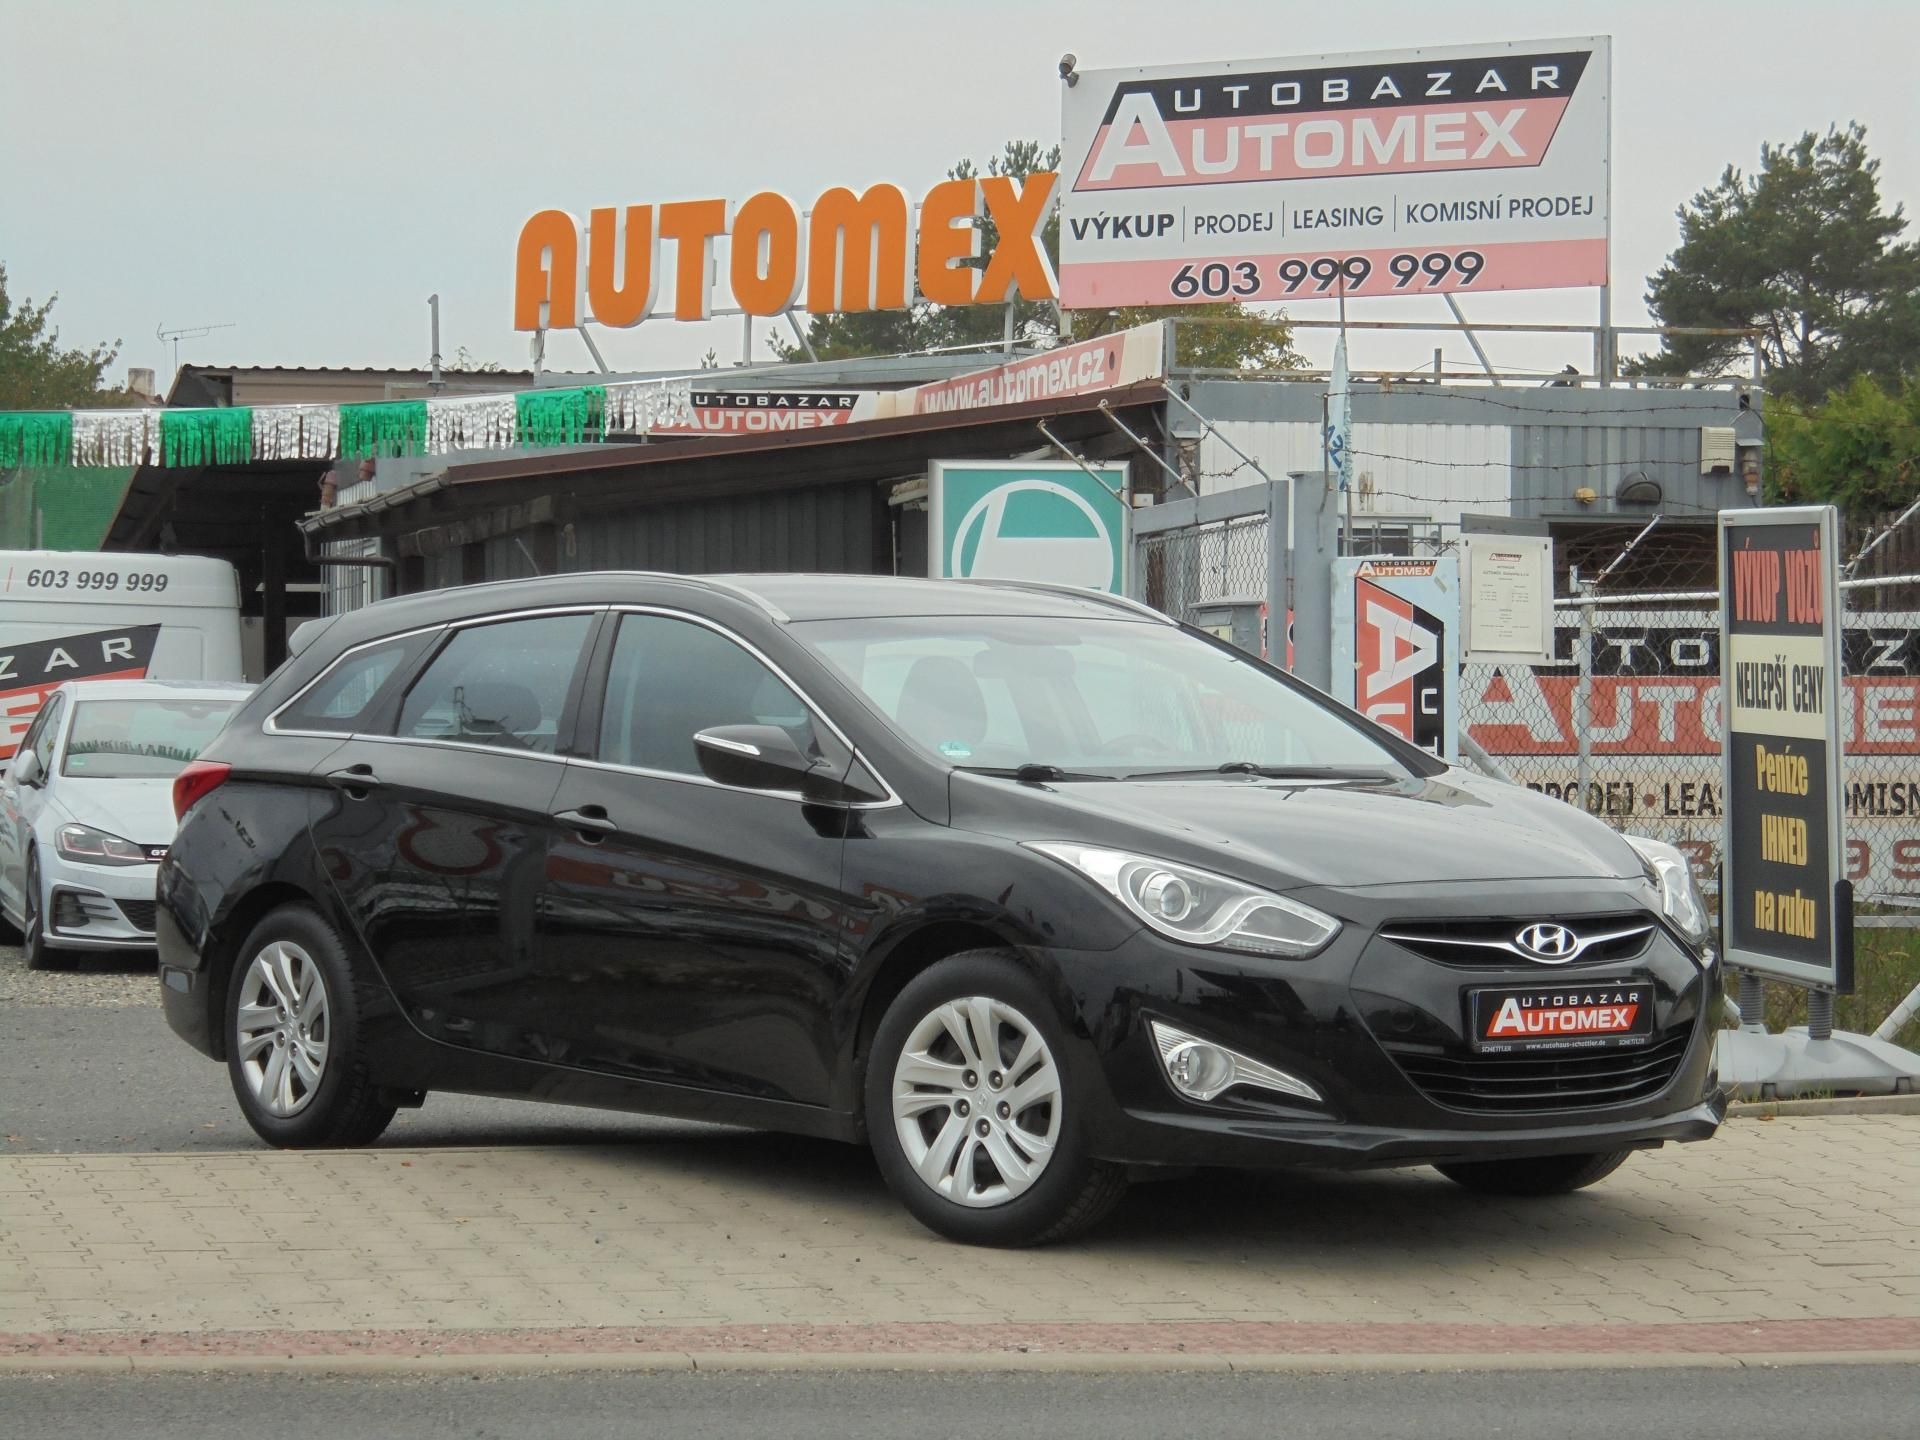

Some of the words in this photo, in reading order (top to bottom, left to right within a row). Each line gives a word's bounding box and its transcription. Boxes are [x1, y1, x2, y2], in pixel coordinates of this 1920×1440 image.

[1088, 91, 1528, 182] AUTOMEX
[1070, 206, 1175, 241] VÝKUP
[1194, 211, 1274, 236] PRODEJ
[1293, 205, 1384, 230] LEASING
[1406, 193, 1503, 225] KOMISNÍ
[1509, 195, 1595, 220] PRODEJ
[515, 171, 1060, 331] AUTOMEX
[1169, 262, 1260, 299] 603
[1278, 256, 1372, 293] 999
[1388, 250, 1485, 288] 999
[924, 347, 1105, 412] www.automex.cz
[27, 569, 69, 588] 603
[76, 571, 119, 590] 999
[126, 573, 168, 592] 999
[1358, 561, 1431, 576] AUTOMEX
[1733, 537, 1780, 623] VÝKUP
[1736, 654, 1787, 711] NEJLEPŠÍ
[1792, 663, 1824, 714] CENY
[1755, 744, 1809, 796] Peníze
[1664, 782, 1722, 816] LEA
[1761, 814, 1808, 866] IHNED
[1754, 890, 1775, 931] na
[1777, 888, 1816, 939] ruku
[1492, 998, 1629, 1033] AUTOMEX
